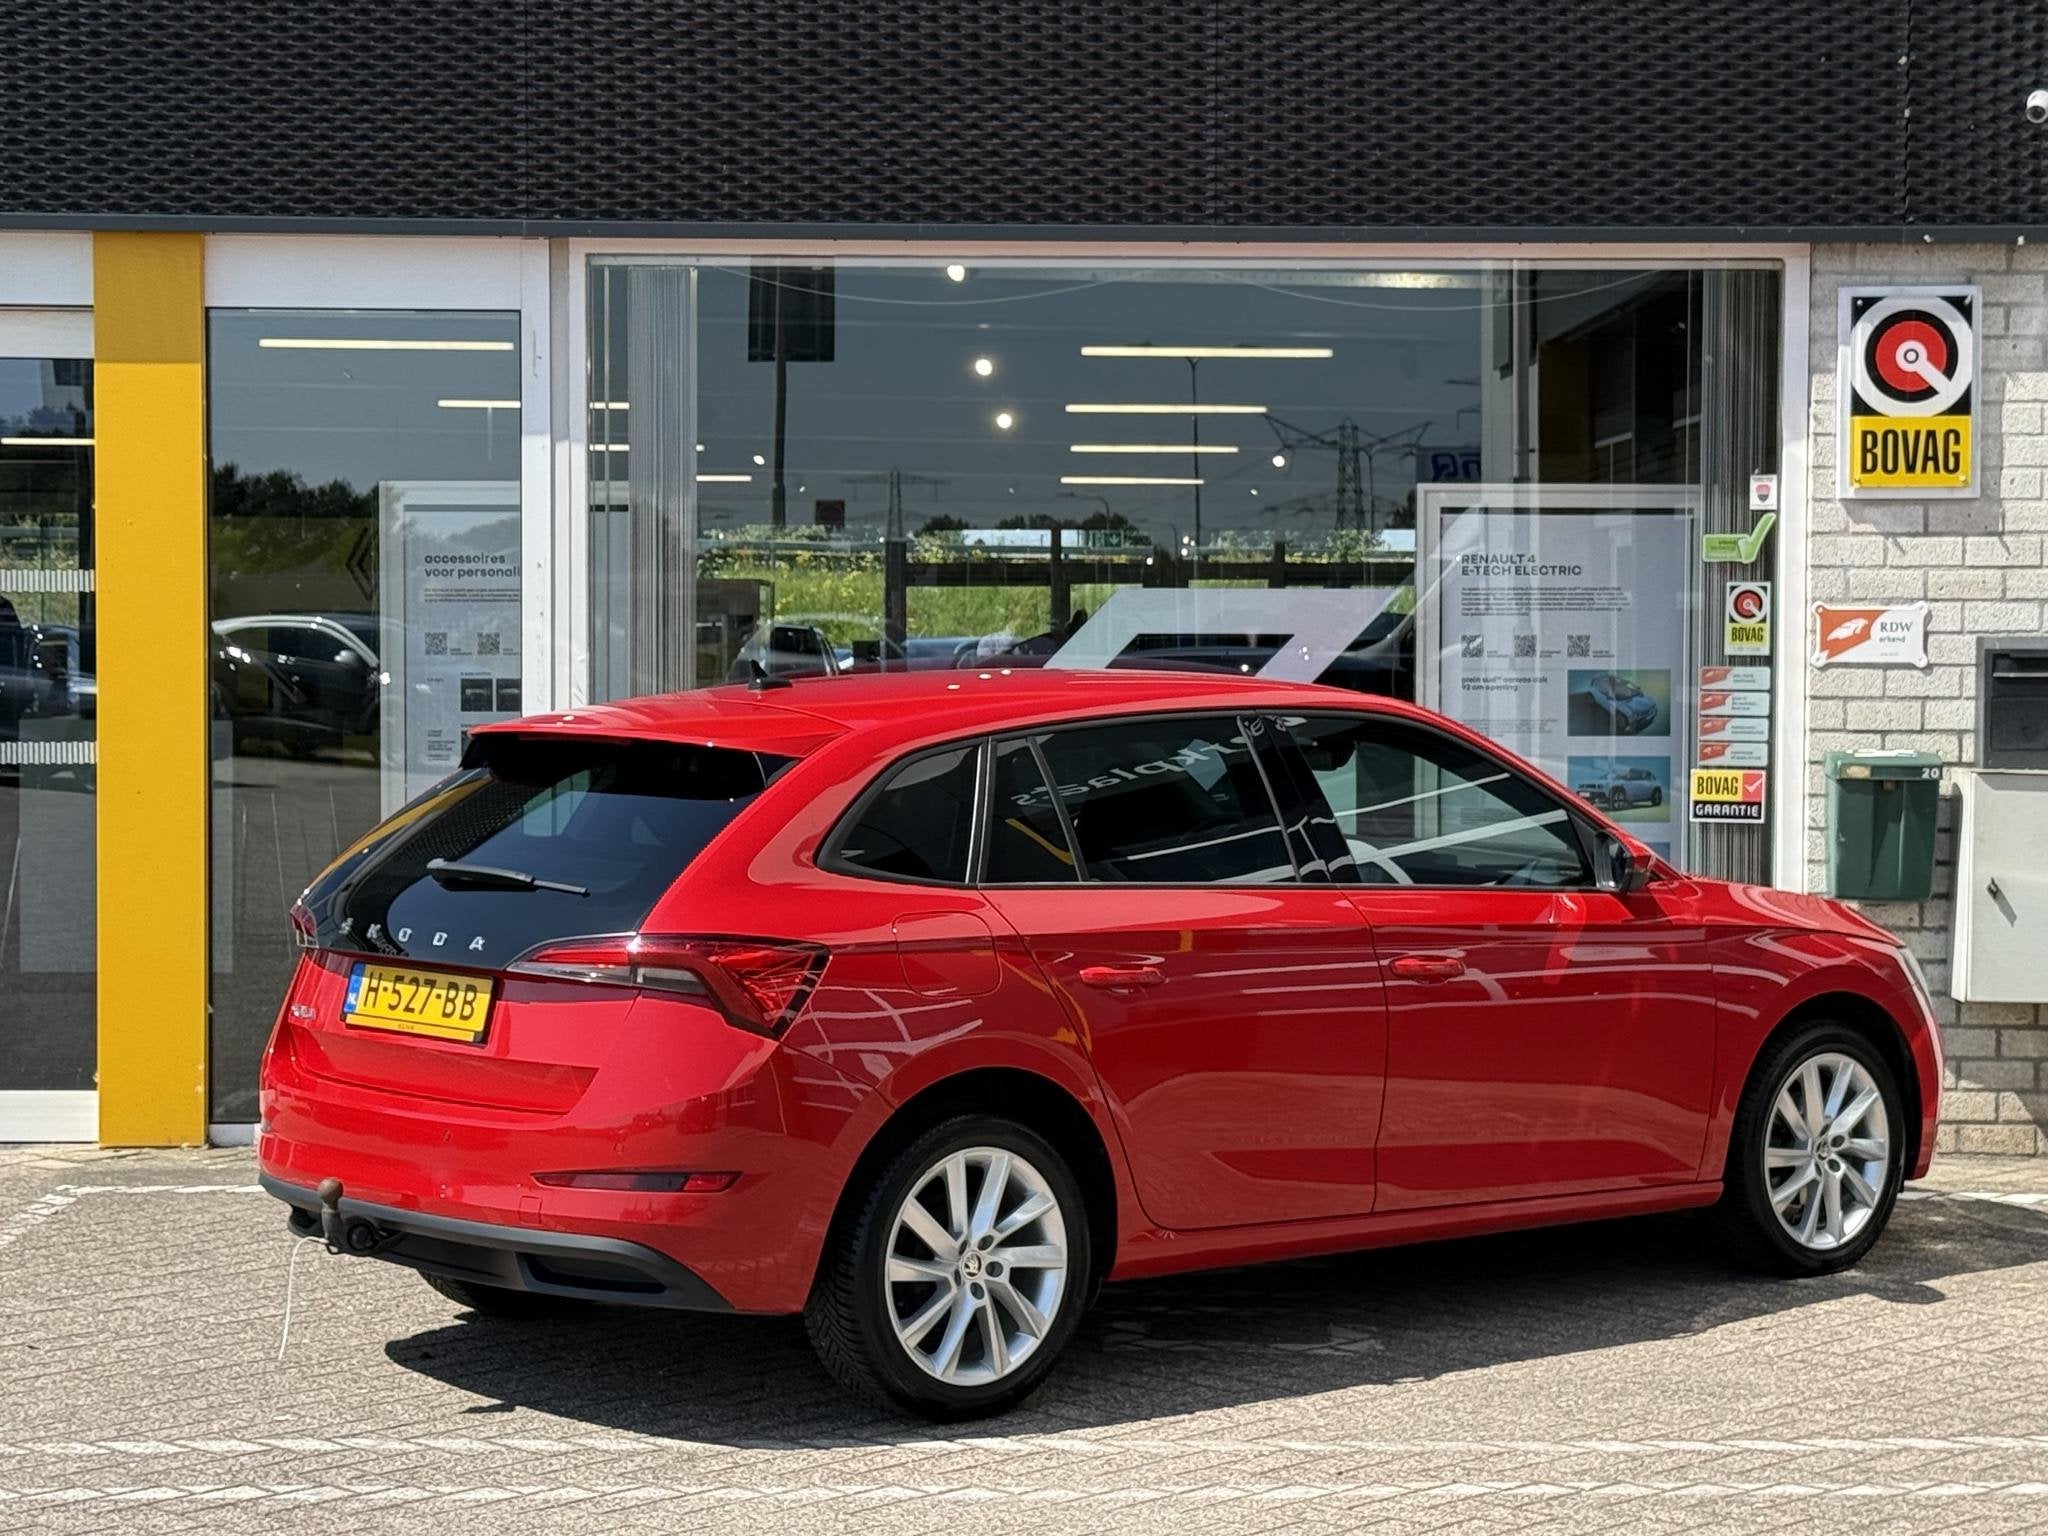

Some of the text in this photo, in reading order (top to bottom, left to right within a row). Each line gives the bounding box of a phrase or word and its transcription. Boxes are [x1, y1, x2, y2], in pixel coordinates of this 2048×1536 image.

[1861, 429, 1961, 475] BOVAG
[424, 553, 506, 565] accessoires
[1461, 554, 1537, 565] RENAULT 4
[424, 567, 455, 578] voor
[1461, 565, 1582, 576] E-TECH ELECTRIC
[1880, 621, 1914, 633] RDW
[1731, 627, 1764, 642] BOVAG
[1921, 767, 1941, 779] 20
[1696, 776, 1739, 797] BOVAG
[1695, 802, 1760, 818] GARANTIE
[363, 971, 479, 1021] H-527-BB
